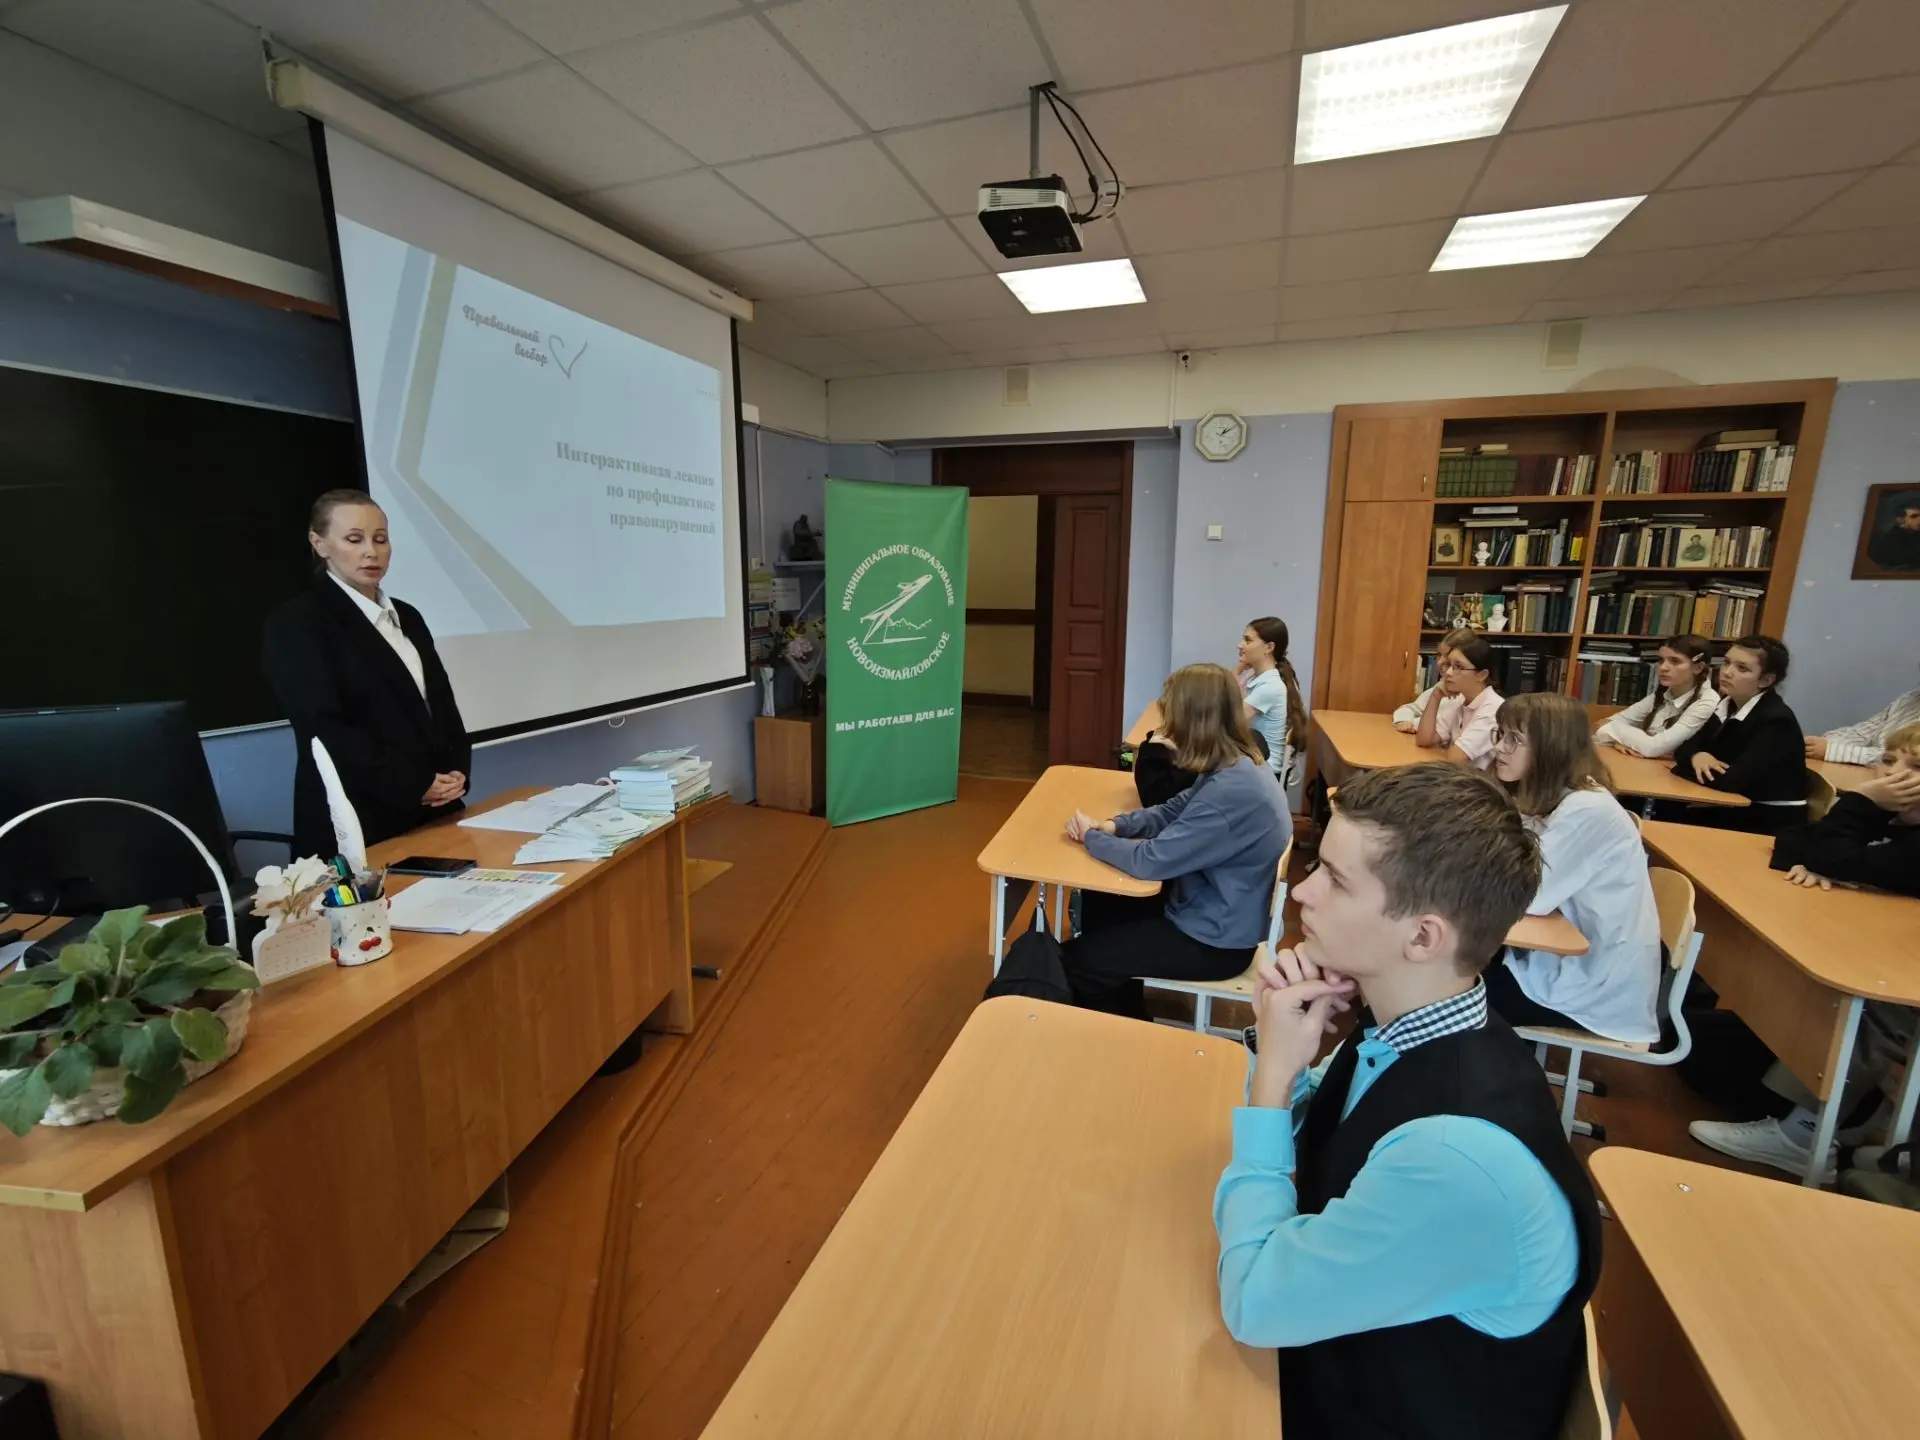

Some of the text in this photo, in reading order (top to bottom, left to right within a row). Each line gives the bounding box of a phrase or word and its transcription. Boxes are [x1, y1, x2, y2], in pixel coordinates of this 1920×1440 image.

[462, 304, 540, 343] Правильный
[514, 342, 548, 367] выбор
[556, 441, 715, 487] Интерактивная лекция
[606, 484, 716, 511] по профилактике
[609, 513, 716, 535] правонарушений
[842, 544, 955, 612] МУНИЦИПАЛЬНОЕ ОБРАЗОВАНИЕ
[846, 631, 950, 681] НОВОИЗМАЙЛОВСКОЕ
[835, 707, 955, 732] МЫ РАБОТАЕМ ДЛЯ ВАС
